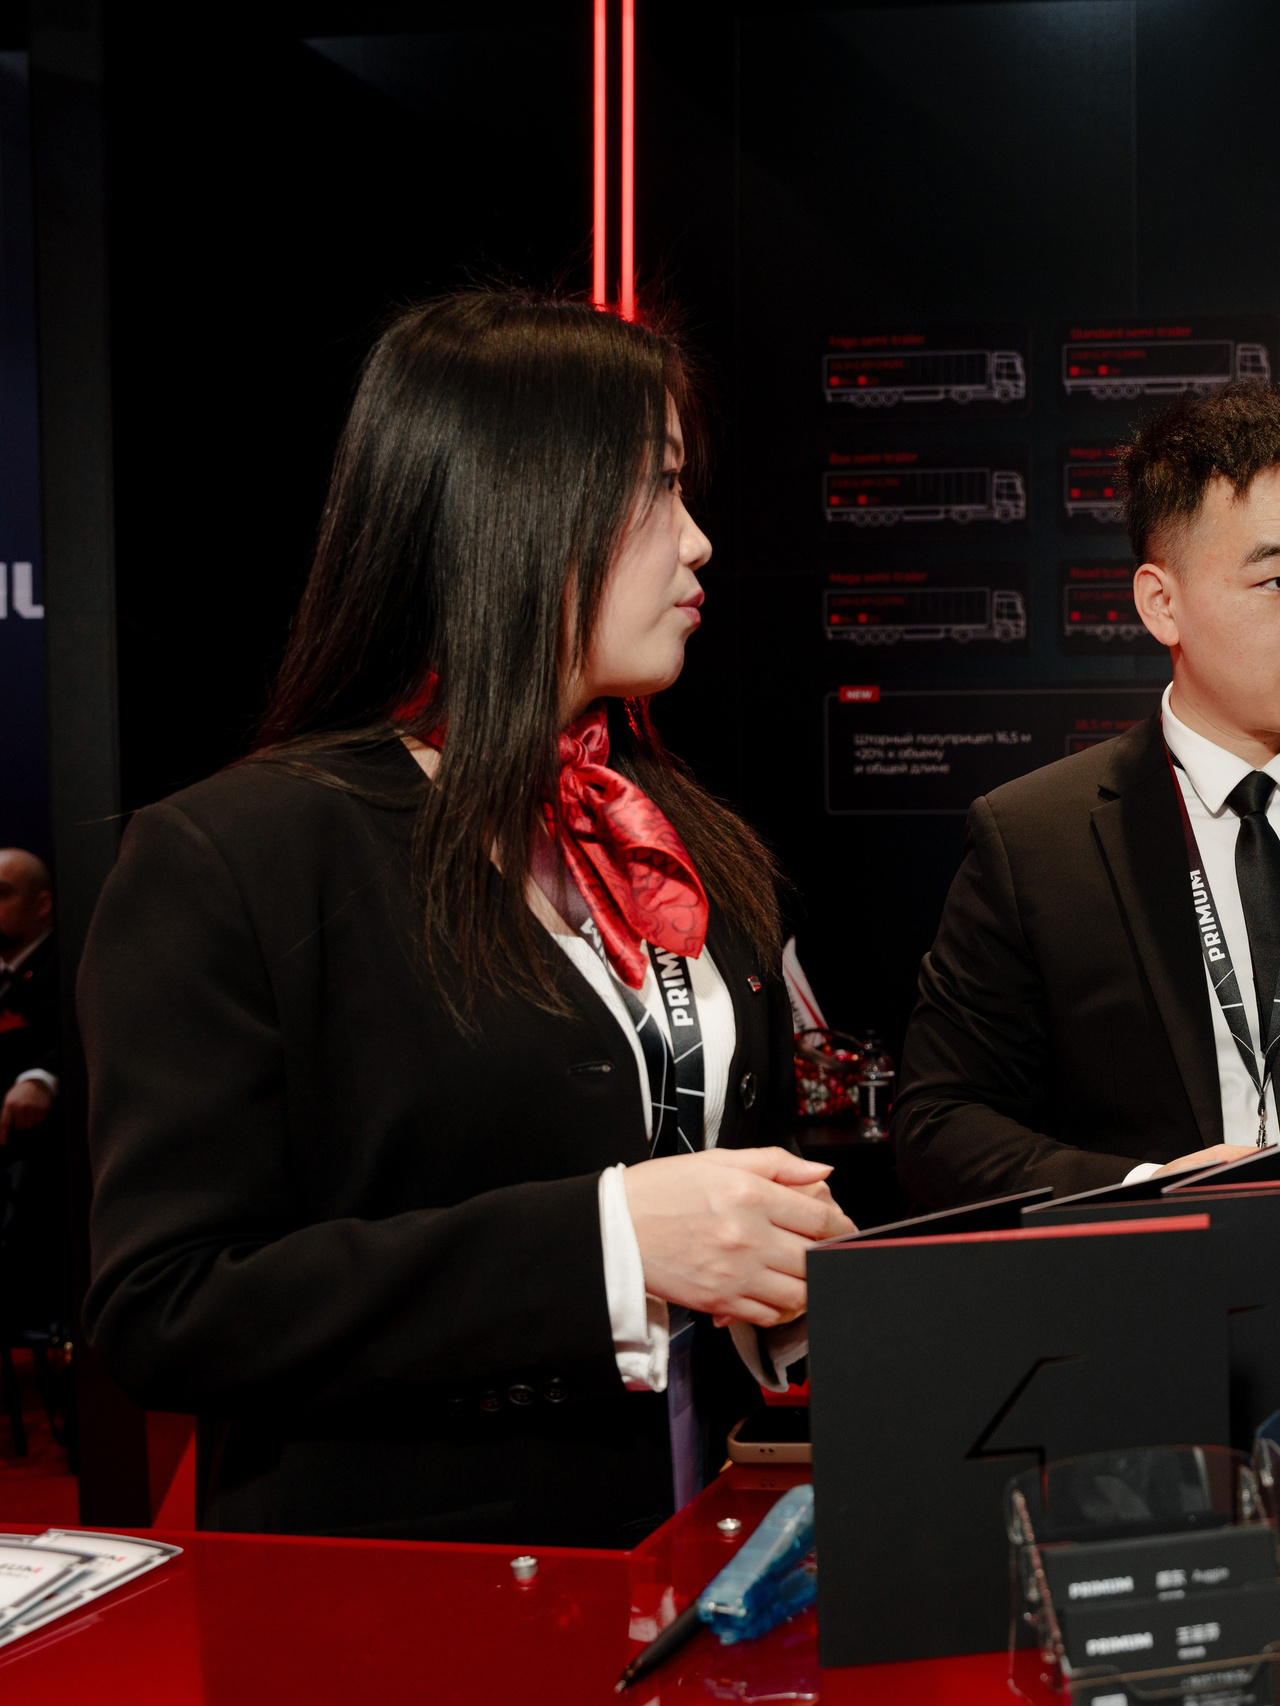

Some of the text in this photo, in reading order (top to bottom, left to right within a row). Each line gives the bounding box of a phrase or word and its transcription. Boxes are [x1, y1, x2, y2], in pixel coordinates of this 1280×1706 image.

[845, 690, 873, 700] NEW
[995, 730, 1018, 746] 16,5
[1189, 869, 1226, 962] PRIMUM
[654, 946, 694, 1027] PRIM
